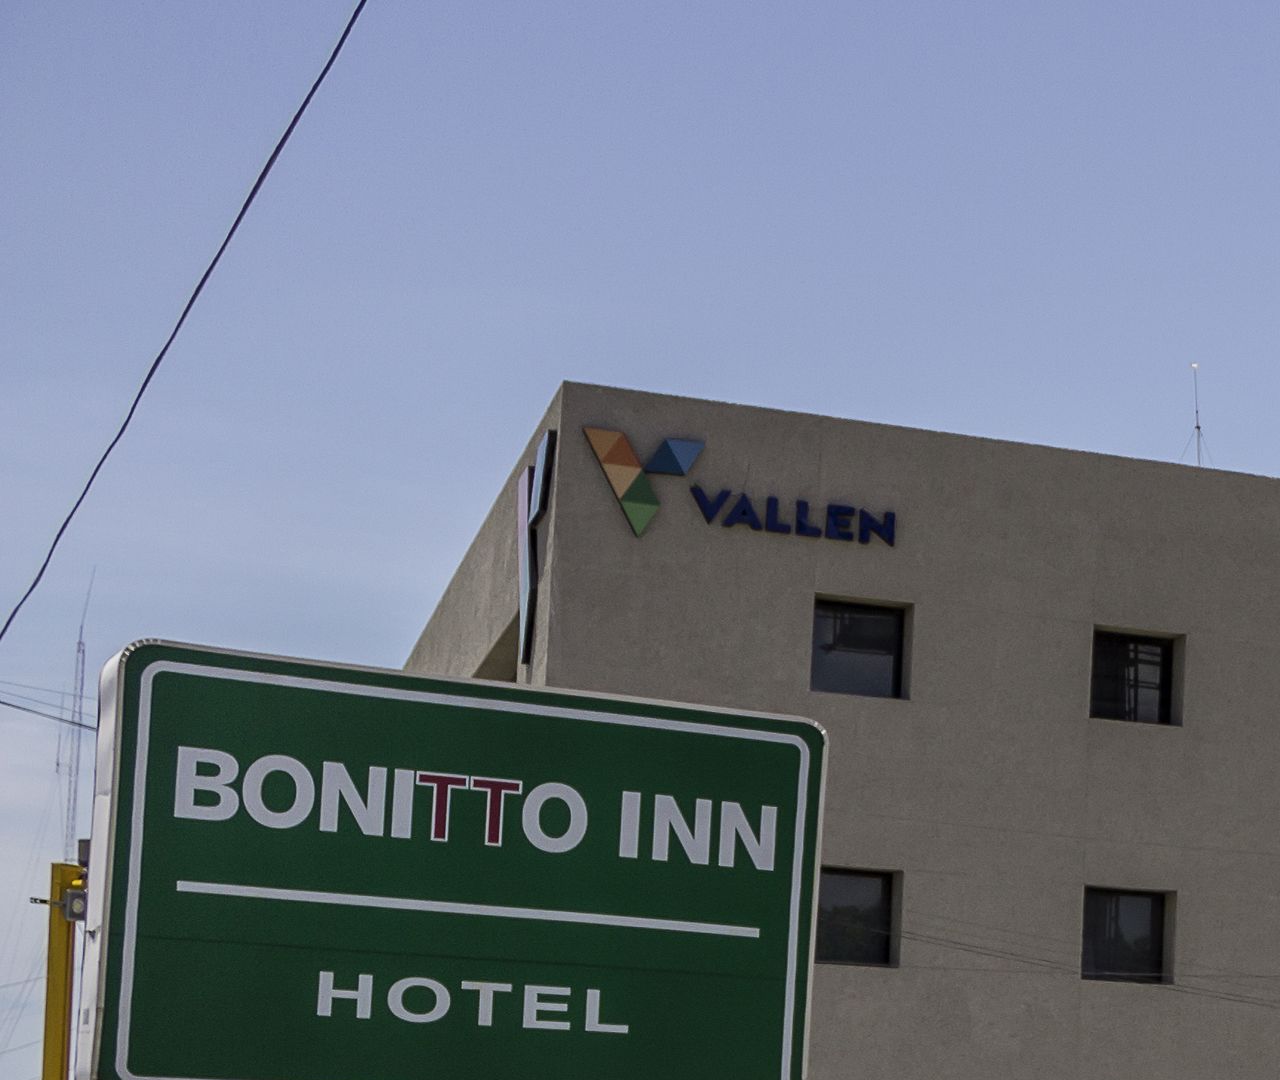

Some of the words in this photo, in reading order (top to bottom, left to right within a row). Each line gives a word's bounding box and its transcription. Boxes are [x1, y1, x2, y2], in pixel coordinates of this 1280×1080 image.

[690, 483, 896, 547] VALLEN
[173, 745, 589, 854] BONITTO
[617, 790, 778, 872] INN
[316, 970, 630, 1034] HOTEL
